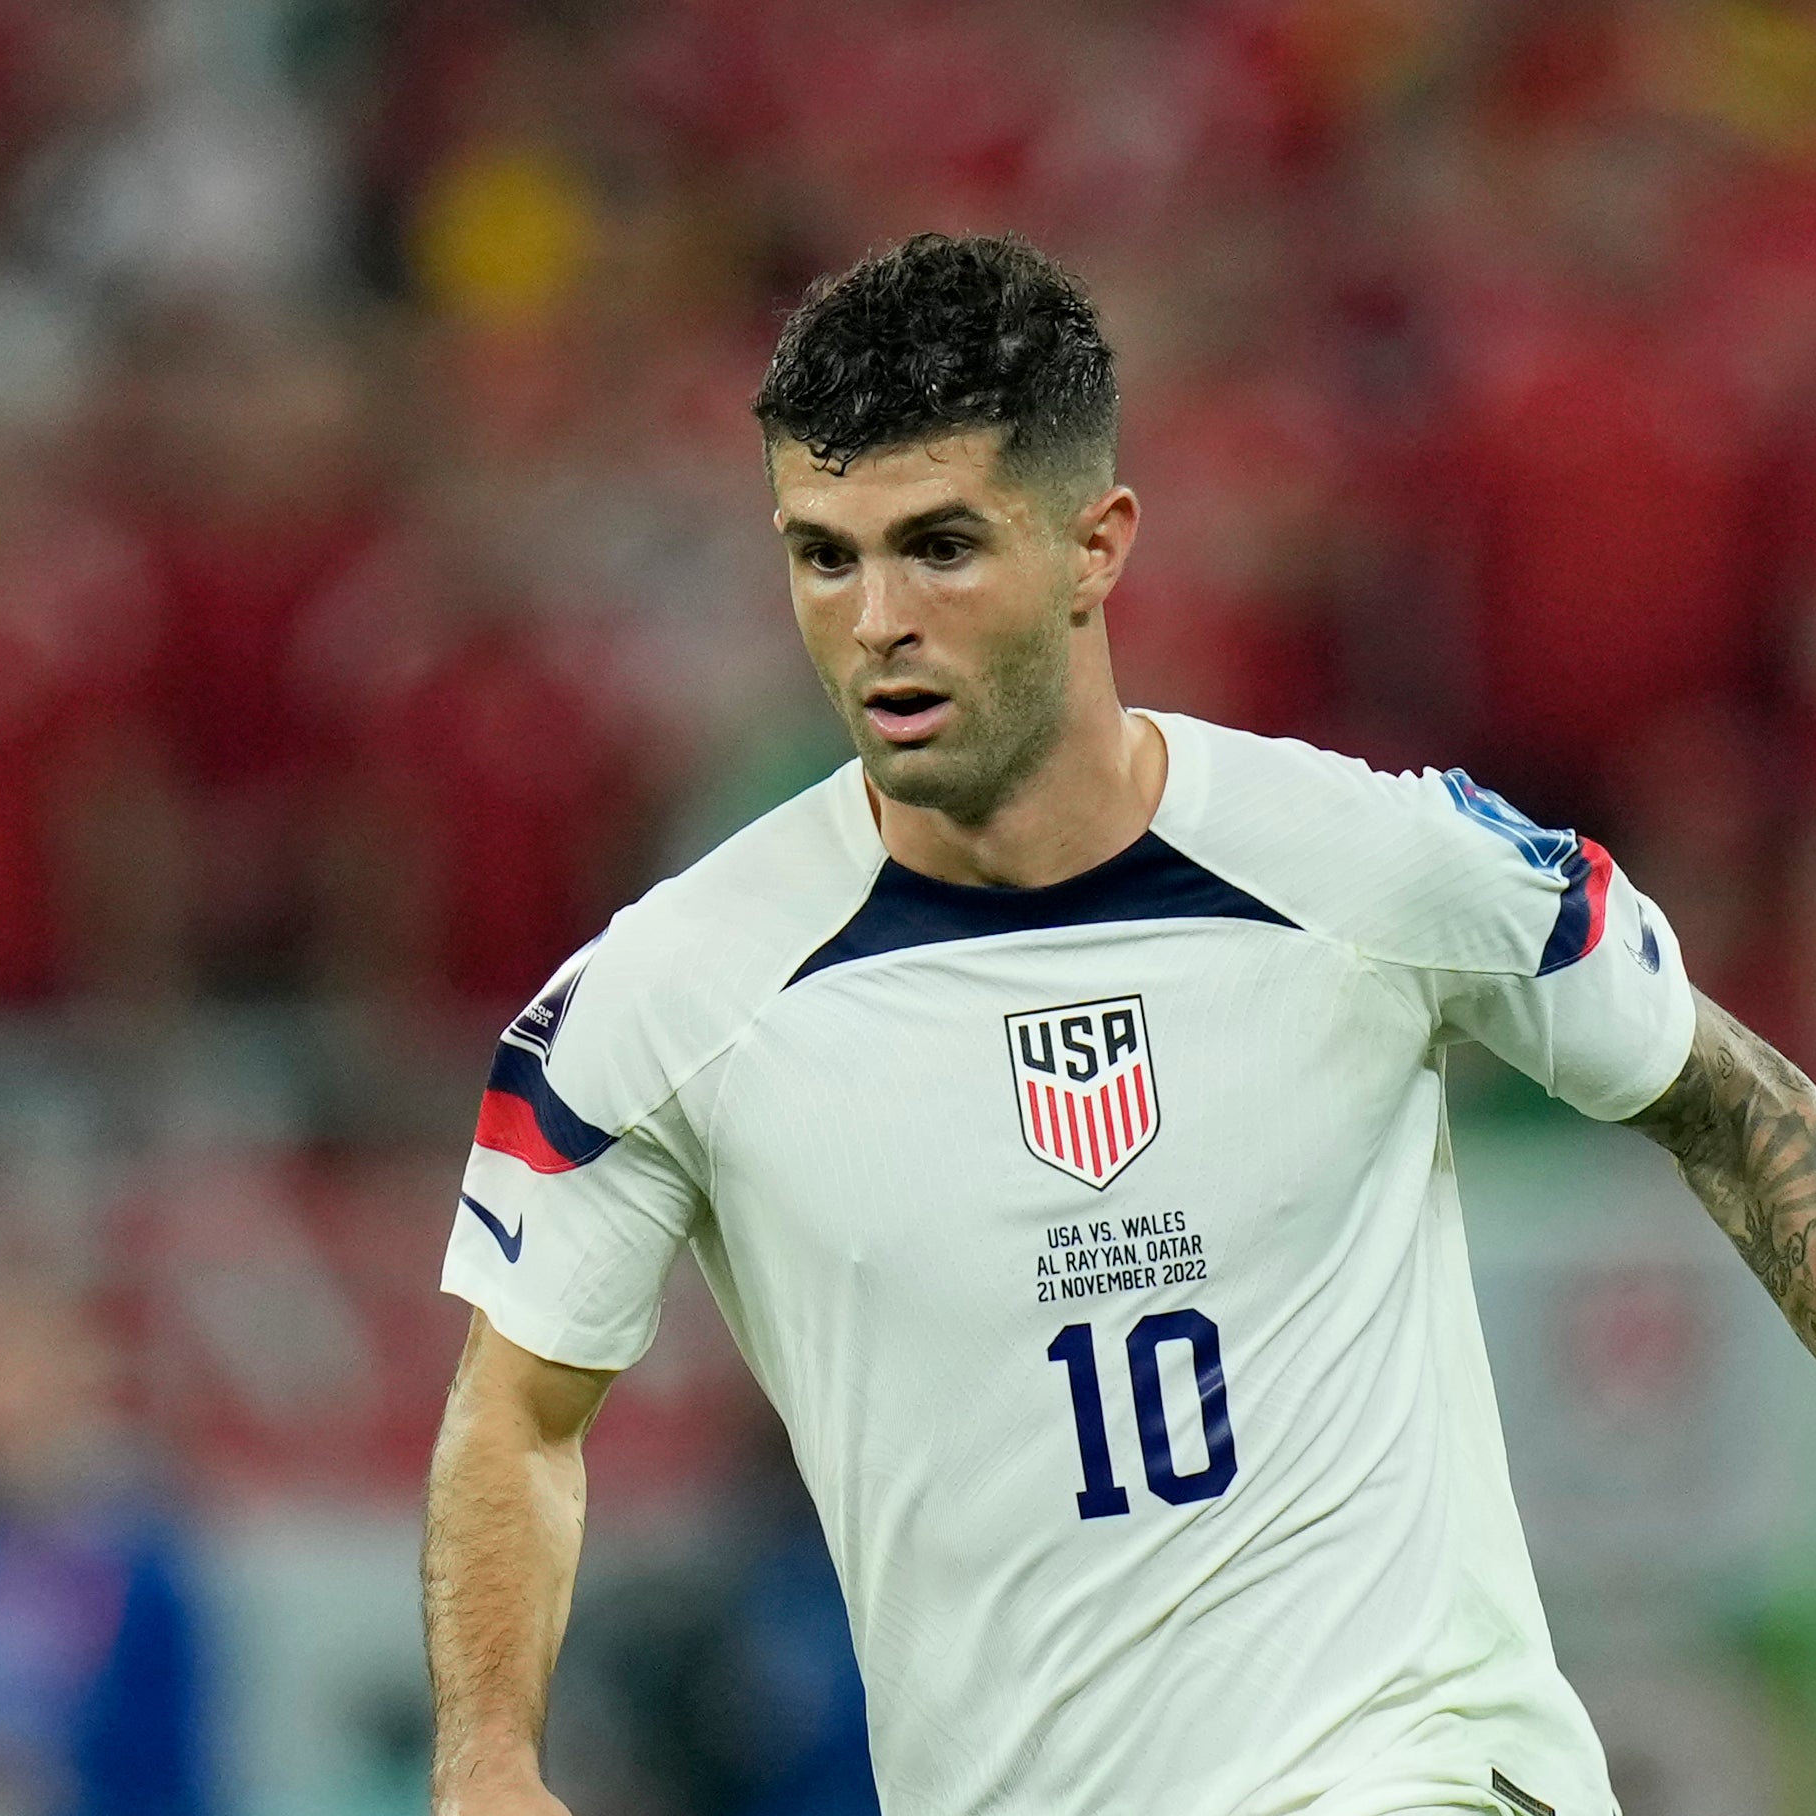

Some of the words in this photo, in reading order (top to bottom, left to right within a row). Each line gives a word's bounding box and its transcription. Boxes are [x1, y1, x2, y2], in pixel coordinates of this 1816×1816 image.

[1018, 1008, 1138, 1083] USA
[1047, 1225, 1083, 1249] USA
[1089, 1221, 1117, 1244] VS.
[1121, 1211, 1186, 1239] WALES
[1037, 1254, 1060, 1277] AL
[1065, 1244, 1142, 1273] RAYYAN,
[1146, 1235, 1203, 1262] QATAR
[1037, 1281, 1057, 1303] 21
[1061, 1267, 1157, 1299] NOVEMBER
[1162, 1259, 1207, 1285] 2022
[1047, 1308, 1238, 1520] 10
